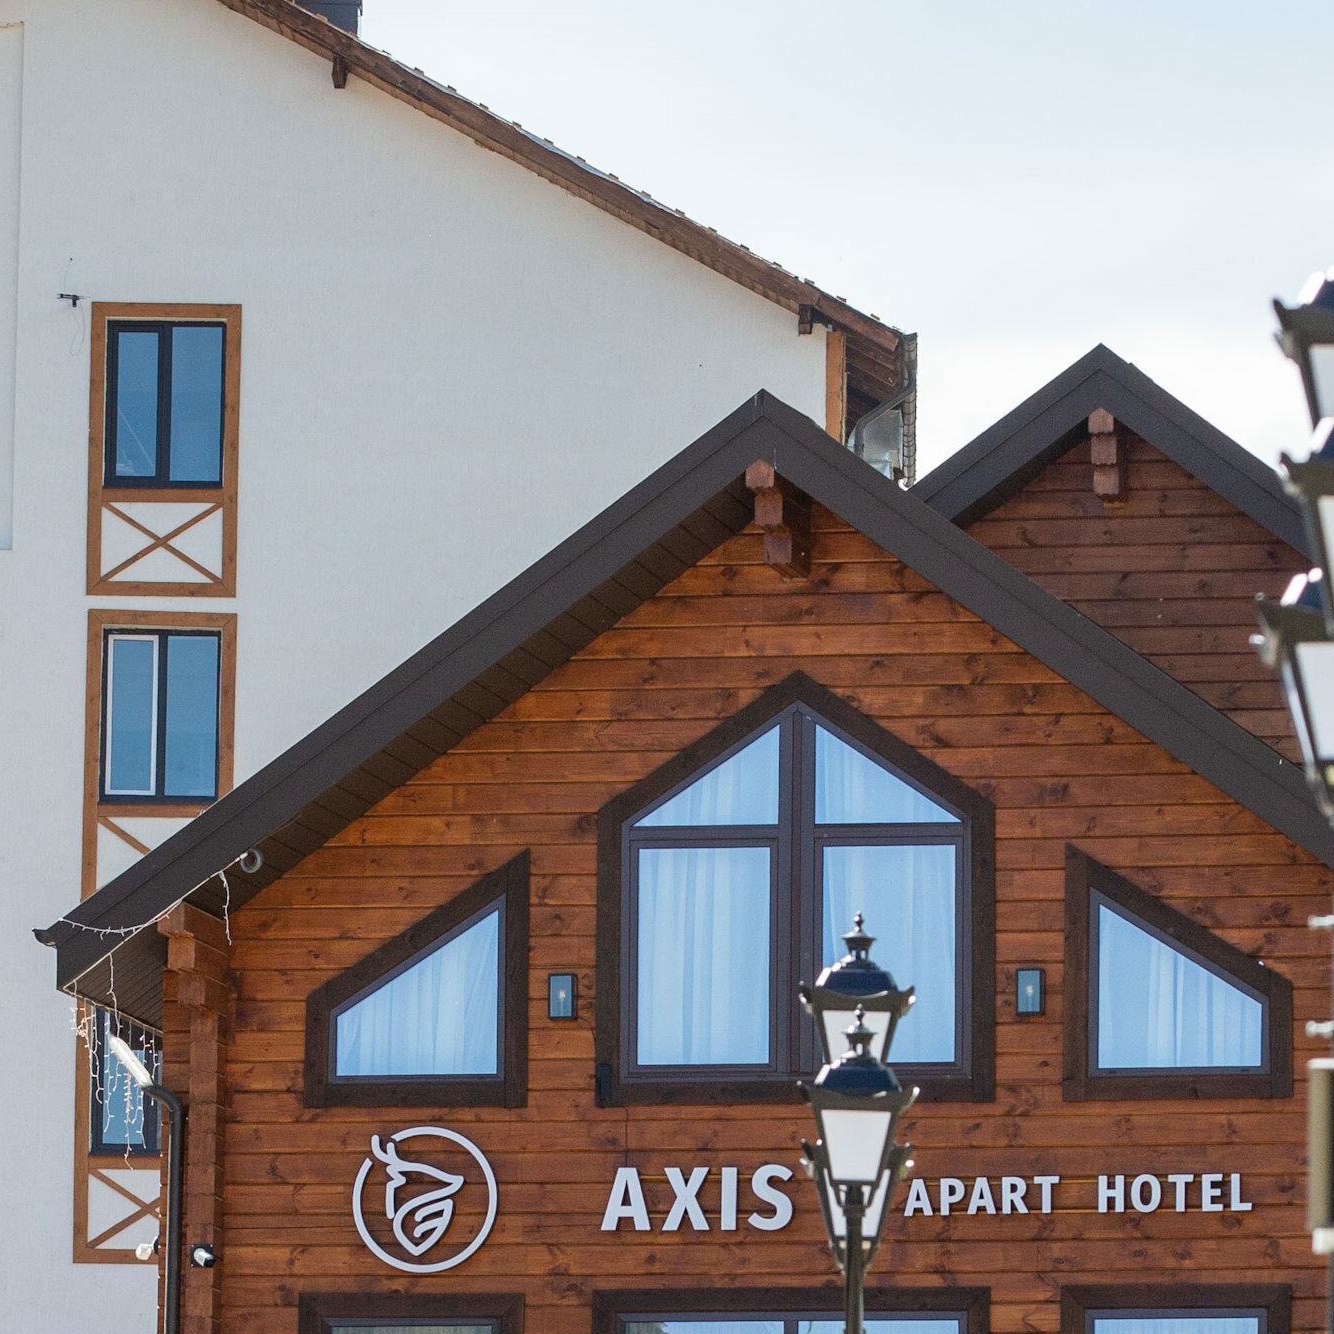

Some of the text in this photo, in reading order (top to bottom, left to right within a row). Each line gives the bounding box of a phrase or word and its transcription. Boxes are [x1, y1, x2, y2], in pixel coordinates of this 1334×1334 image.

[600, 1163, 1254, 1231] AXIS APART HOTEL
